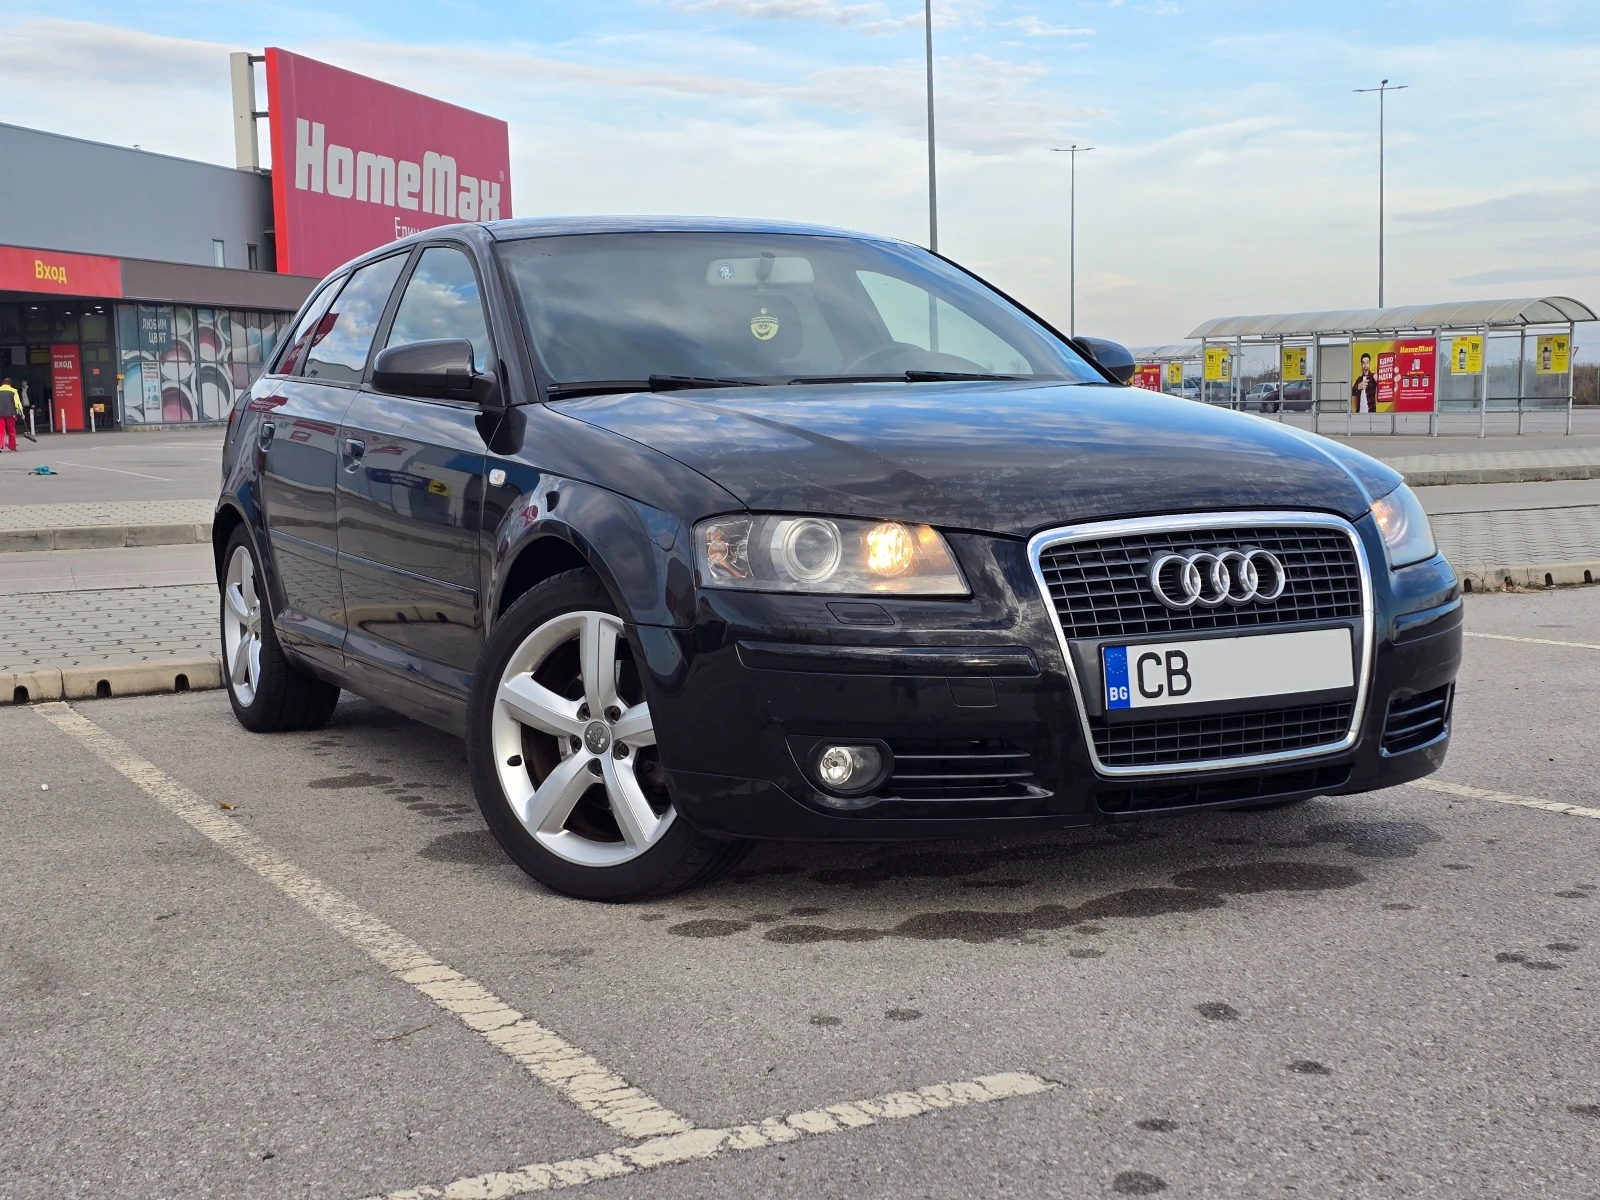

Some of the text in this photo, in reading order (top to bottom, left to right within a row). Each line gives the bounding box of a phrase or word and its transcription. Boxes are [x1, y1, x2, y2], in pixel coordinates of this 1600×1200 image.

[295, 117, 500, 221] HomeMax
[35, 259, 67, 284] Вход
[142, 318, 167, 330] ЛЮБИМ
[149, 333, 166, 345] ЦВЯТ
[54, 361, 72, 369] ВХОД
[1137, 650, 1192, 698] CB
[1109, 686, 1128, 701] BG
